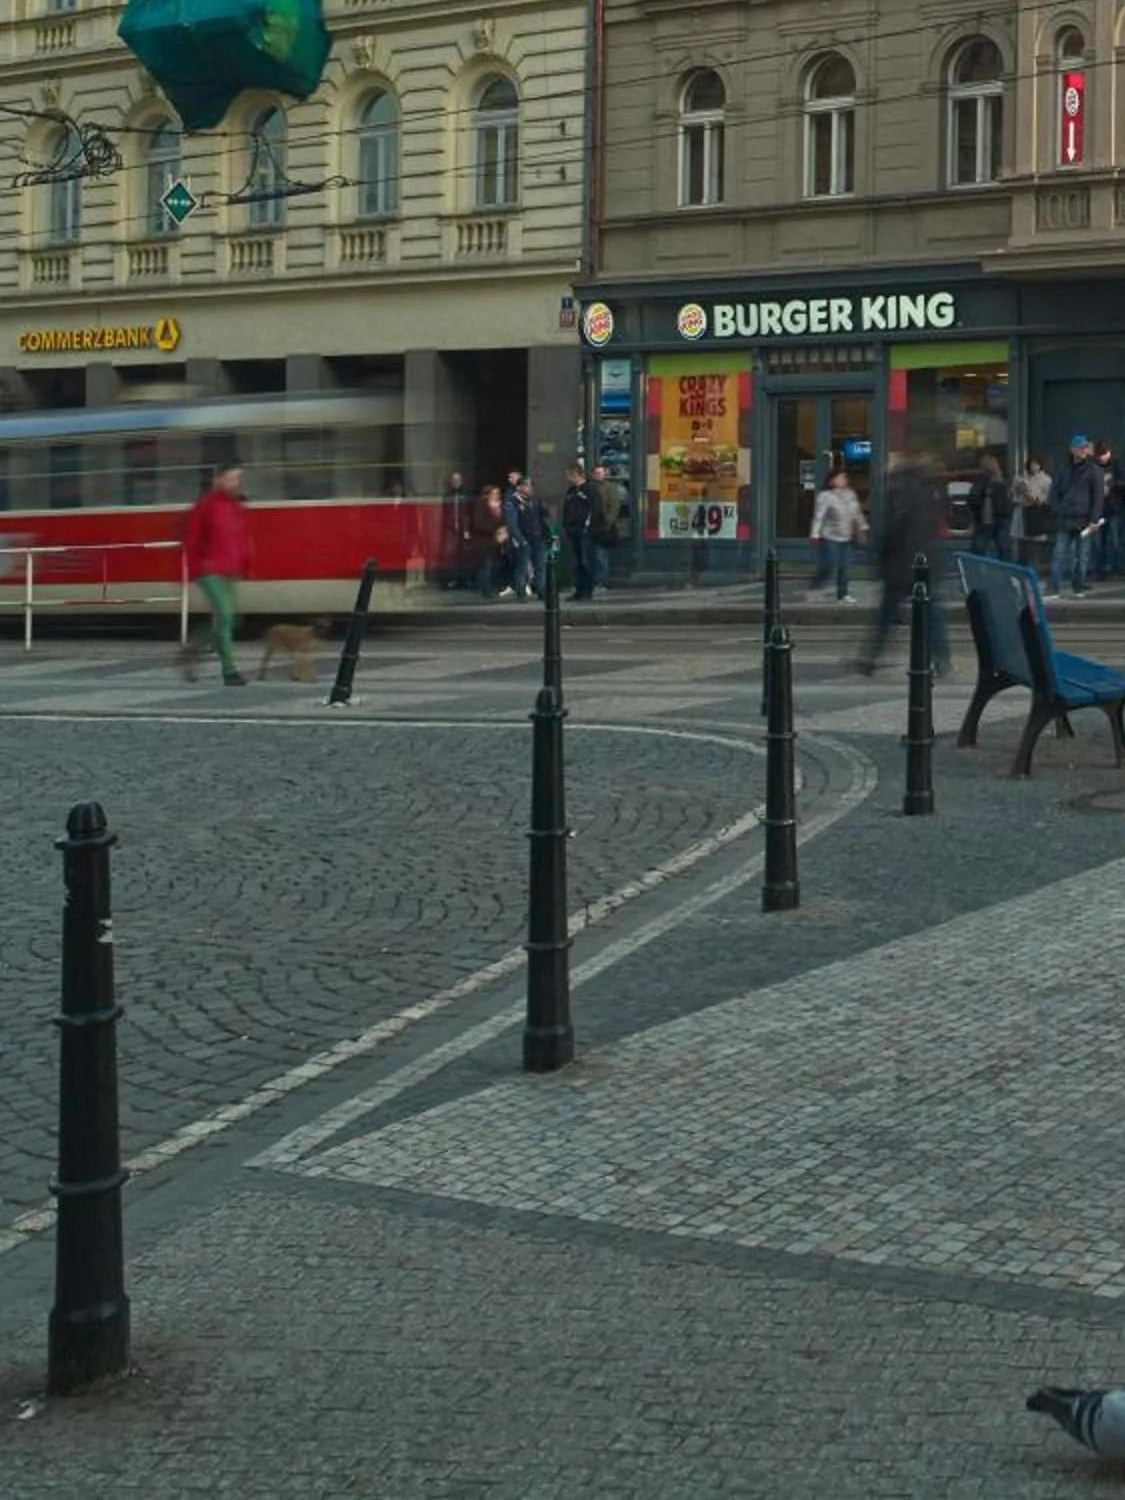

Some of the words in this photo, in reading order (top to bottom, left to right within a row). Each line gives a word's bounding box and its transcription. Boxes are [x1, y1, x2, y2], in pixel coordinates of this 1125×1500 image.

[713, 299, 853, 337] BURGER
[861, 292, 955, 330] KING
[17, 327, 149, 350] COMMERZBANK
[679, 374, 727, 396] CRAZY
[679, 398, 727, 417] KINGS
[692, 503, 723, 536] 49
